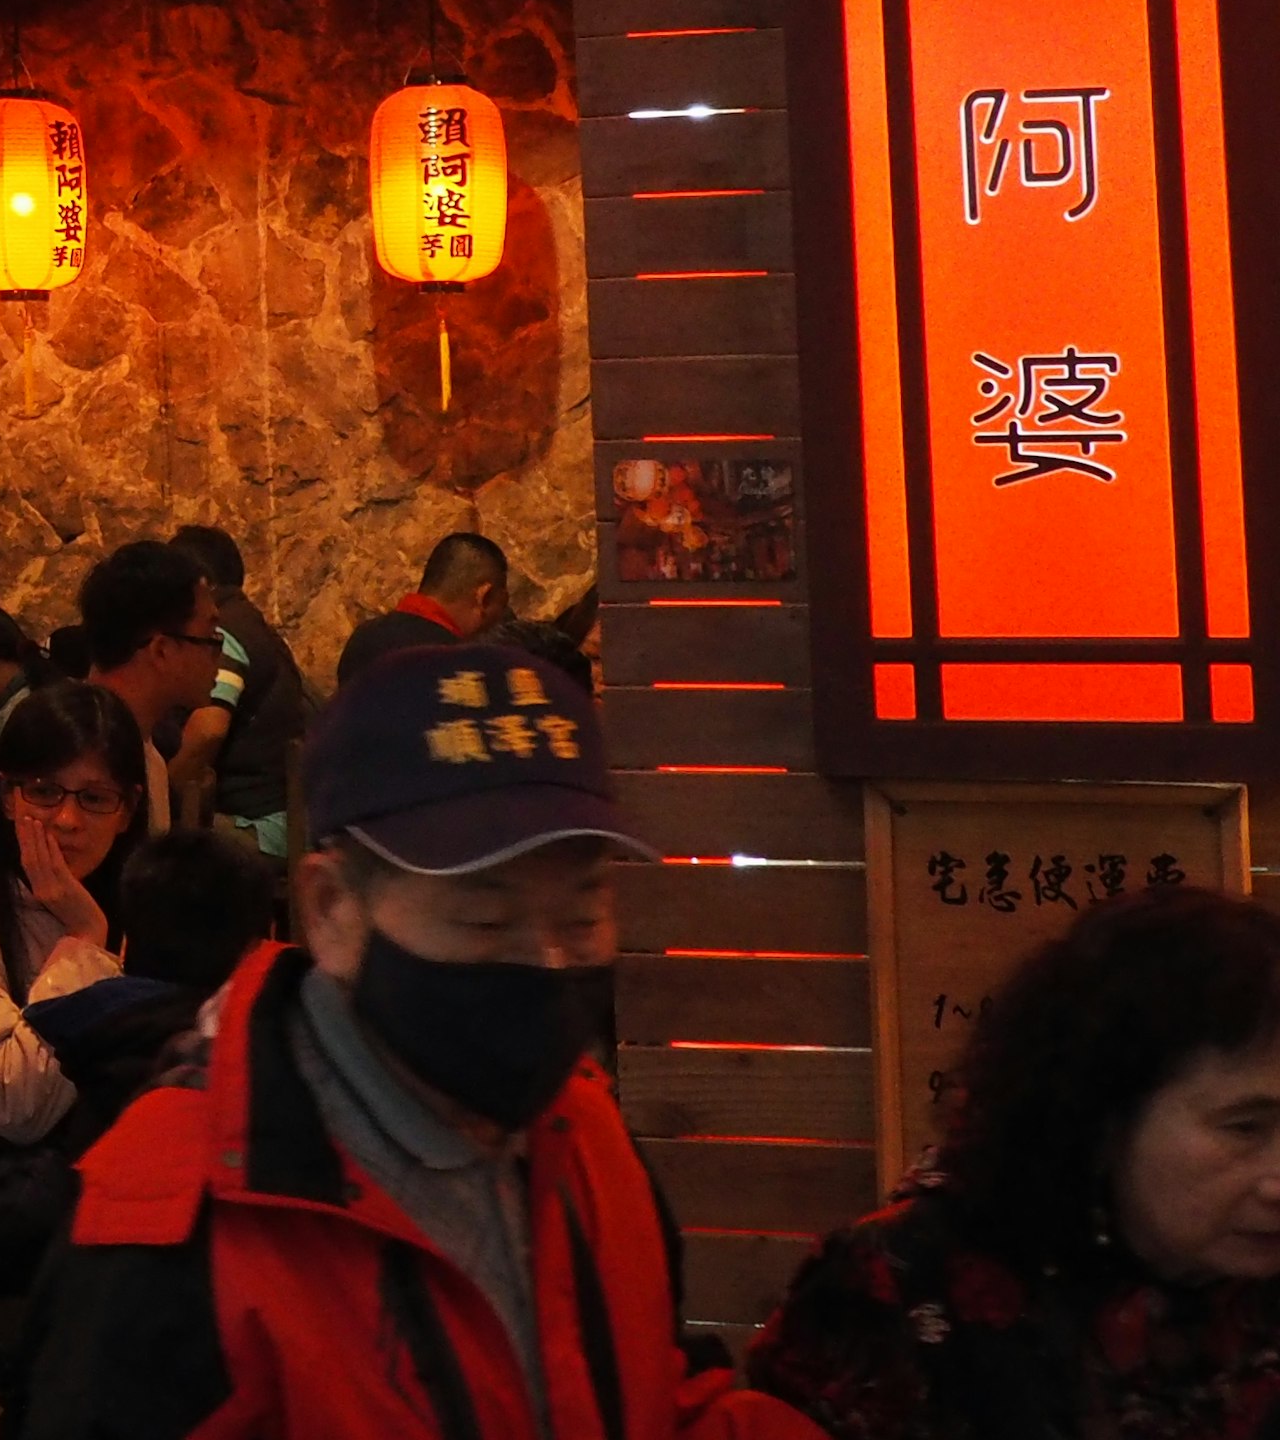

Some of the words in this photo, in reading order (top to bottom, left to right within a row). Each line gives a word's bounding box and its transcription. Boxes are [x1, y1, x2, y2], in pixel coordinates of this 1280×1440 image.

[49, 121, 84, 242] 賴阿婆
[416, 106, 470, 230] 賴阿婆
[420, 232, 474, 260] 芋圓
